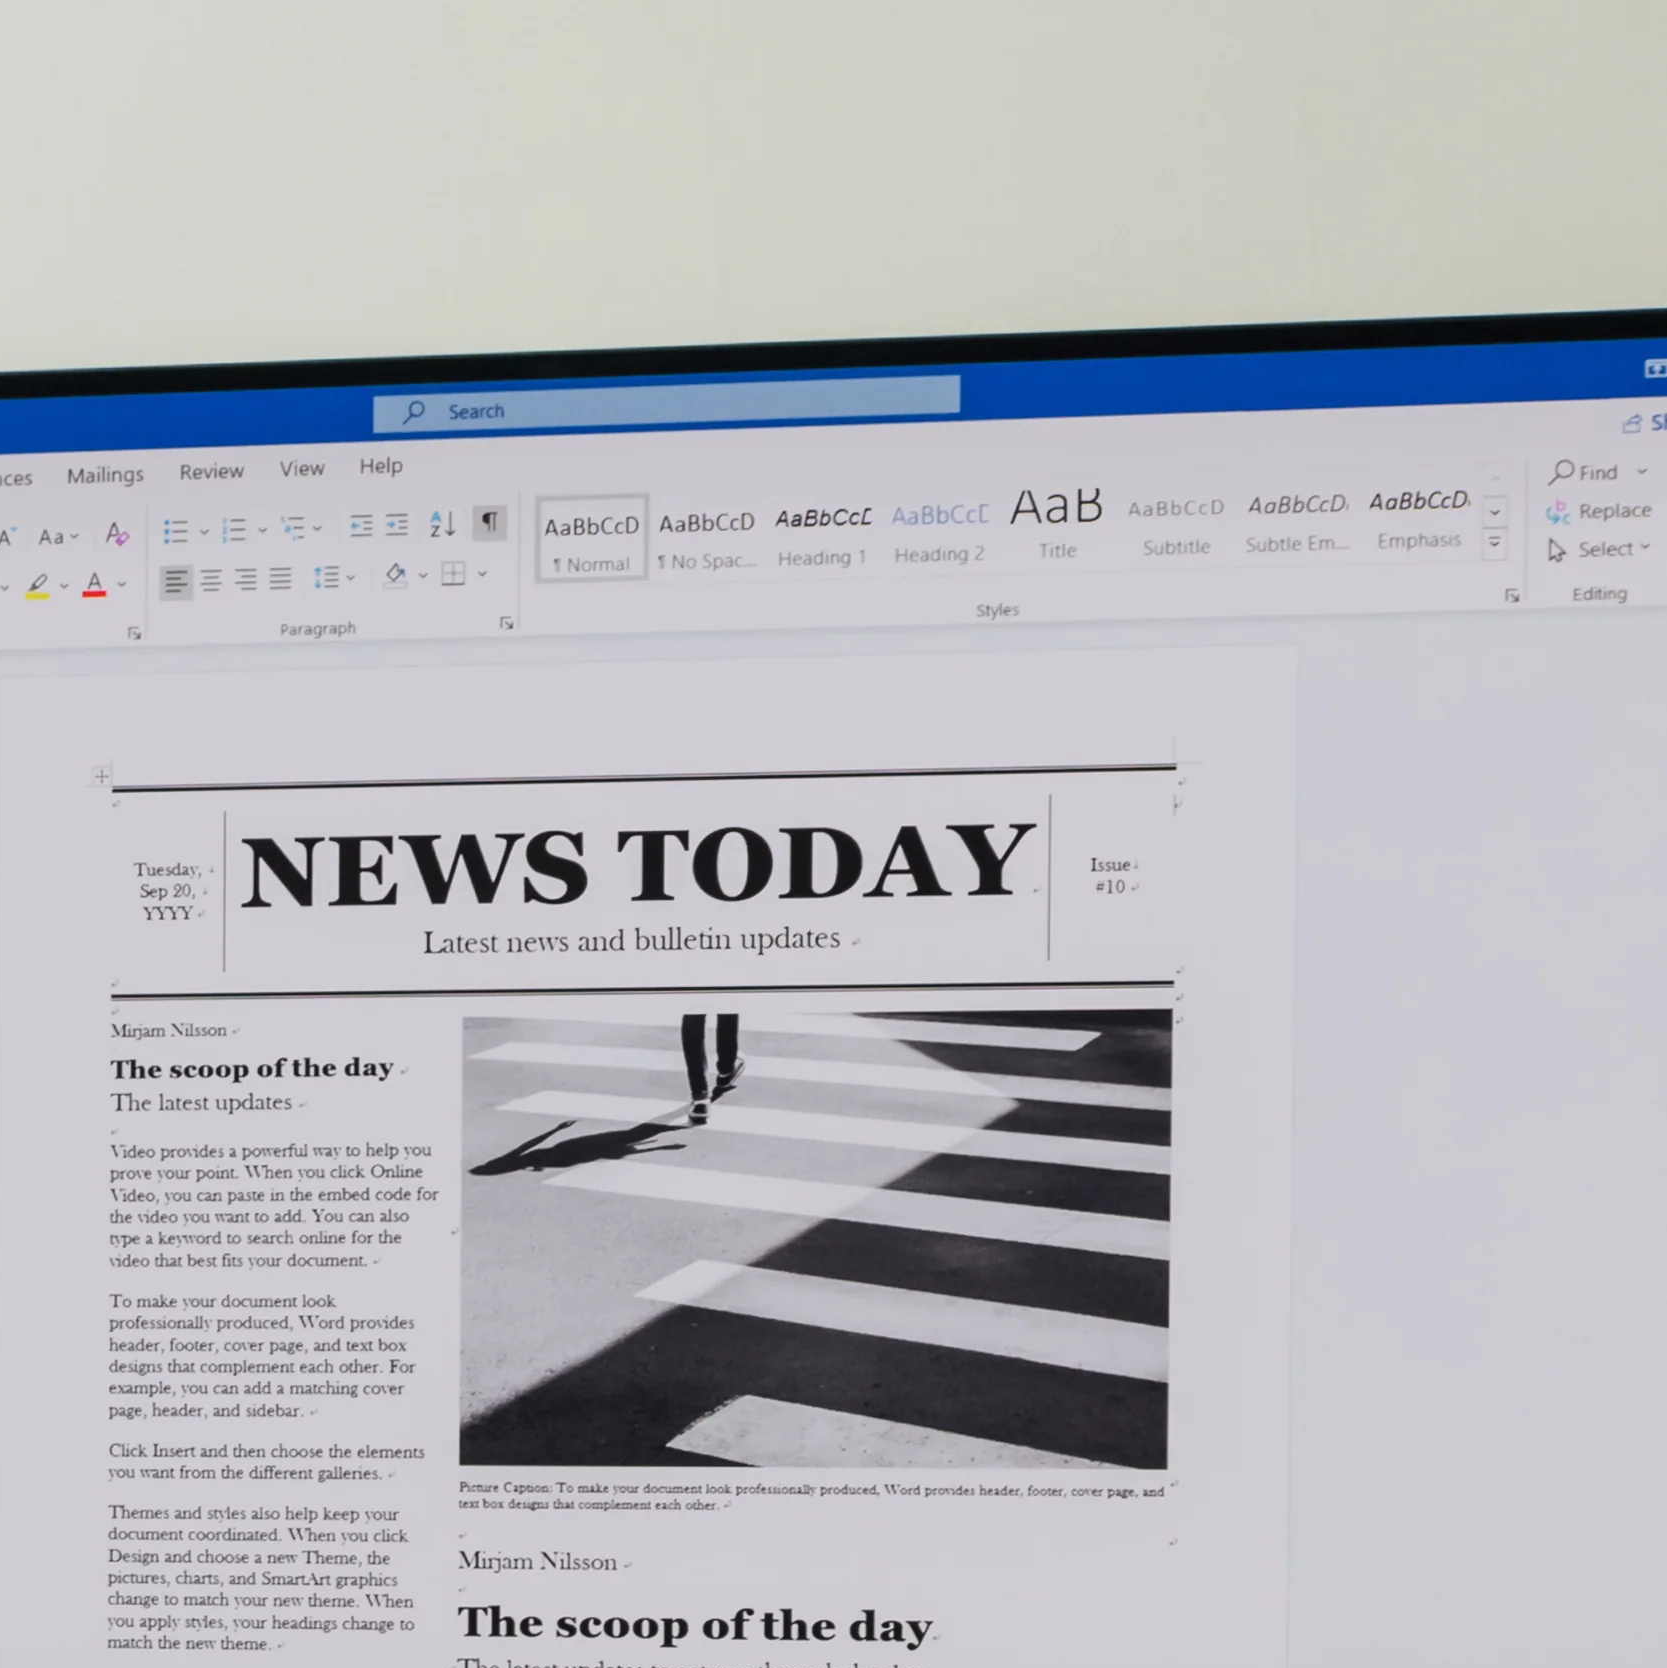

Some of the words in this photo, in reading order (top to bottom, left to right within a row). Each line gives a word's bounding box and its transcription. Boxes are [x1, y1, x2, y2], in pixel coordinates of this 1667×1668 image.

[449, 402, 505, 421] Search
[68, 466, 145, 489] Mailings
[180, 461, 245, 481] Review
[280, 458, 325, 478] View
[360, 456, 404, 479] Help
[1580, 463, 1618, 481] Find
[1128, 498, 1225, 518] AaBbCcD
[1579, 501, 1653, 521] Replace
[544, 515, 640, 538] AaBbCcD
[659, 512, 755, 534] AaBbCcD
[1040, 542, 1077, 559] Title
[1143, 539, 1211, 556] Subtitle
[1246, 536, 1302, 553] Subtle
[1379, 532, 1462, 552] Emphasis
[1579, 539, 1635, 558] Select
[568, 554, 631, 574] Normal
[671, 552, 697, 571] No
[778, 550, 851, 569] Heading
[858, 549, 866, 565] 1
[895, 546, 969, 565] Heading
[974, 545, 985, 562] 2
[1573, 585, 1628, 605] Editing
[976, 601, 1020, 620] Styles
[280, 621, 356, 640] Paragraph
[134, 861, 203, 881] Tuesday,
[241, 830, 589, 908] NEWS
[617, 823, 1038, 903] TODAY
[1090, 856, 1132, 874] Issue
[140, 883, 167, 902] Sep
[172, 883, 196, 901] 20,
[1095, 878, 1126, 895] #10
[143, 905, 194, 921] YYYY
[424, 931, 498, 955] Latest
[507, 937, 568, 953] news
[578, 929, 624, 952] and
[635, 927, 730, 951] bulletin
[741, 926, 840, 956] updates
[111, 1024, 165, 1041] Mirjam
[171, 1023, 226, 1038] Nilsson
[110, 1059, 161, 1080] The
[170, 1065, 249, 1084] scoop
[257, 1058, 287, 1078] of
[292, 1058, 336, 1078] the
[344, 1057, 393, 1082] day
[110, 1092, 151, 1112] The
[159, 1093, 209, 1112] latest
[216, 1093, 292, 1116] updates
[111, 1144, 155, 1159] Video
[161, 1144, 224, 1162] provides
[229, 1148, 237, 1159] a
[242, 1143, 308, 1161] powerful
[313, 1147, 341, 1161] way
[346, 1146, 361, 1158] to
[366, 1142, 399, 1161] help
[404, 1147, 431, 1160] you
[110, 1170, 151, 1184] prove
[157, 1170, 190, 1183] your
[196, 1166, 238, 1184] point.
[245, 1165, 293, 1180] When
[298, 1169, 325, 1182] you
[330, 1165, 365, 1179] click
[371, 1164, 423, 1179] Online
[109, 1316, 212, 1333] professionally
[217, 1316, 293, 1333] produced,
[299, 1315, 344, 1330] Word
[350, 1316, 414, 1333] provides
[109, 1443, 147, 1458] Click
[153, 1443, 196, 1458] Insert
[200, 1444, 228, 1459] and
[233, 1443, 265, 1459] then
[271, 1443, 323, 1459] choose
[329, 1444, 351, 1459] the
[357, 1445, 425, 1460] elements
[459, 1500, 479, 1509] text
[482, 1498, 504, 1510] box
[508, 1499, 549, 1512] designs
[553, 1498, 575, 1510] that
[578, 1500, 651, 1512] complement
[655, 1499, 681, 1511] each
[685, 1499, 719, 1511] other.
[459, 1551, 533, 1574] Mirjam
[541, 1552, 617, 1571] Nilsson
[108, 1574, 170, 1588] pictures,
[175, 1570, 223, 1588] charts,
[229, 1572, 256, 1586] and
[262, 1571, 331, 1587] SmartArt
[336, 1572, 398, 1590] graphics
[458, 1605, 543, 1637] The
[556, 1617, 688, 1648] scoop
[703, 1608, 754, 1640] of
[761, 1609, 835, 1641] the
[850, 1610, 933, 1651] day
